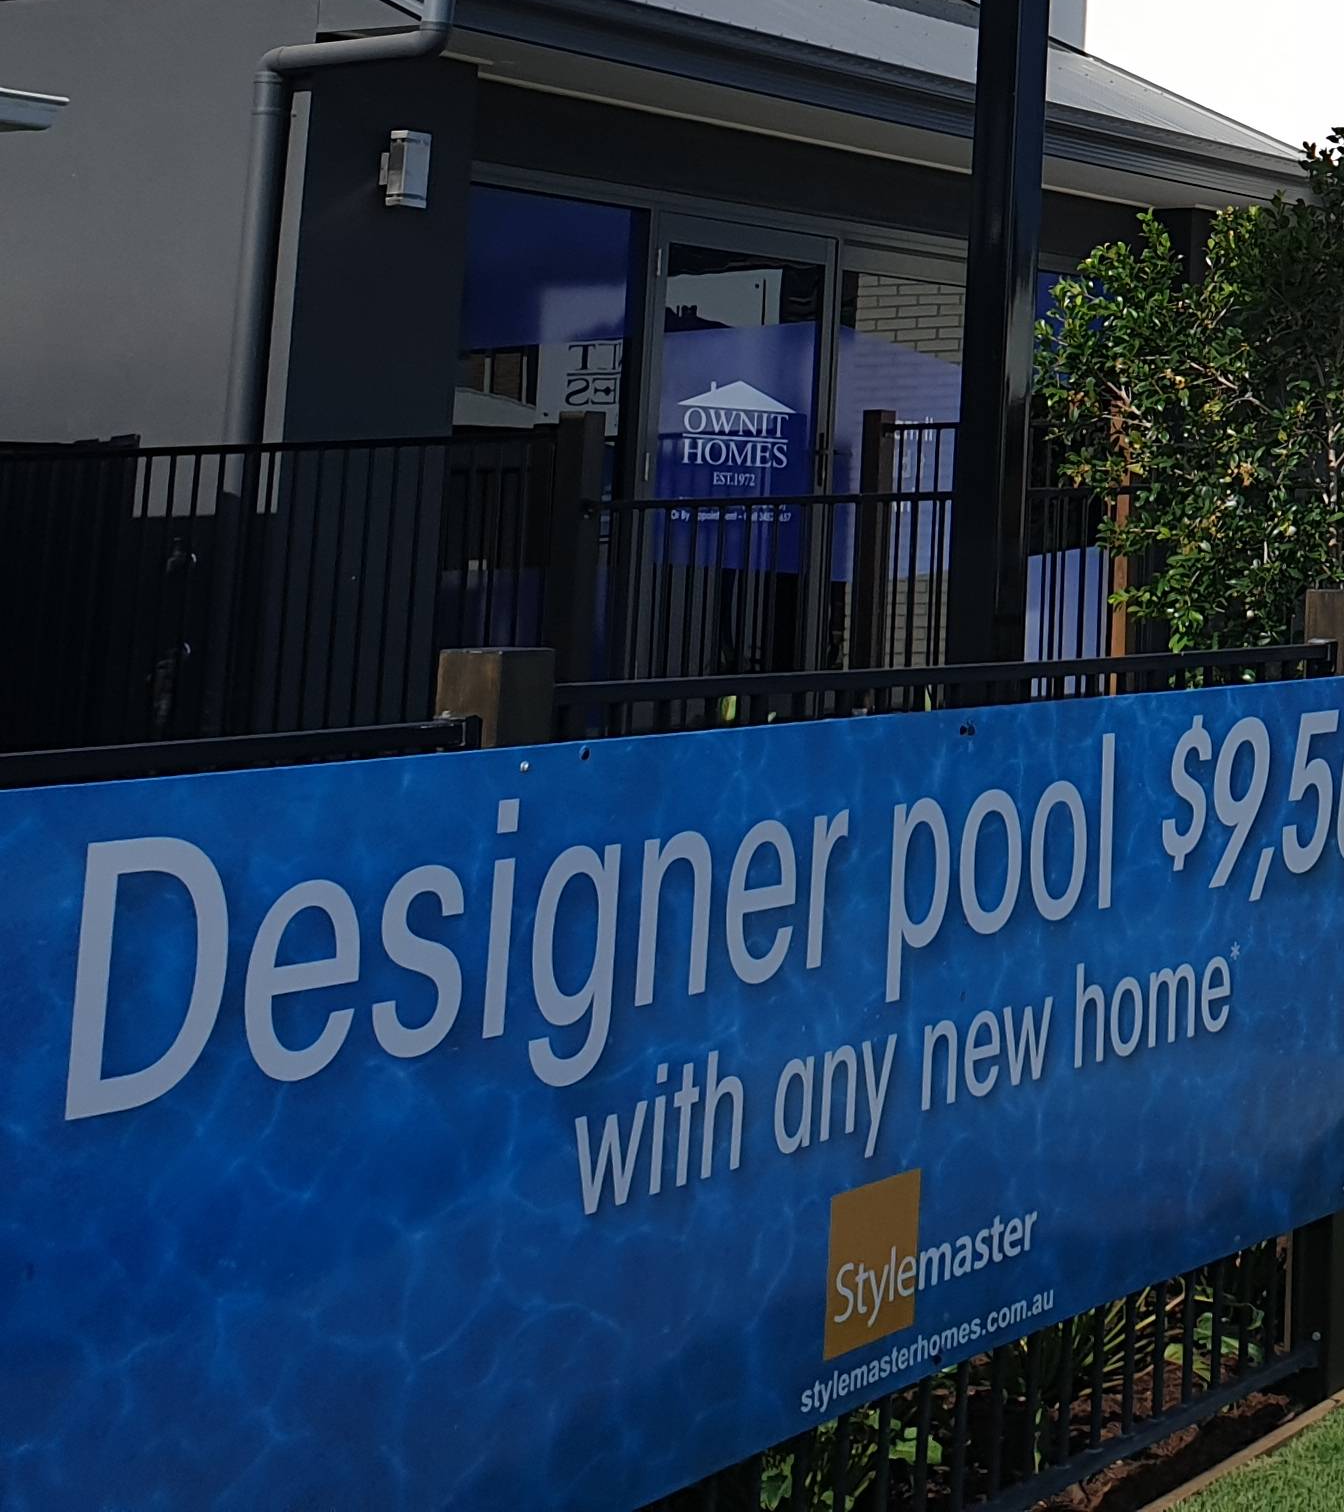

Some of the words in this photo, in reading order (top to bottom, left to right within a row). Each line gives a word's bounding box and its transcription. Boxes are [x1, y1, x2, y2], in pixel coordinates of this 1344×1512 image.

[681, 439, 789, 469] HOMES
[682, 408, 790, 439] OWNIT
[713, 471, 756, 487] EST.1972
[63, 799, 854, 1121] Designer
[884, 734, 1115, 1002] pool
[574, 1050, 744, 1216] with
[774, 1033, 898, 1159] any
[919, 996, 1053, 1111] new
[833, 1209, 1038, 1328] Stylemaster
[799, 1289, 1055, 1415] stylemasterhomes.com.au
